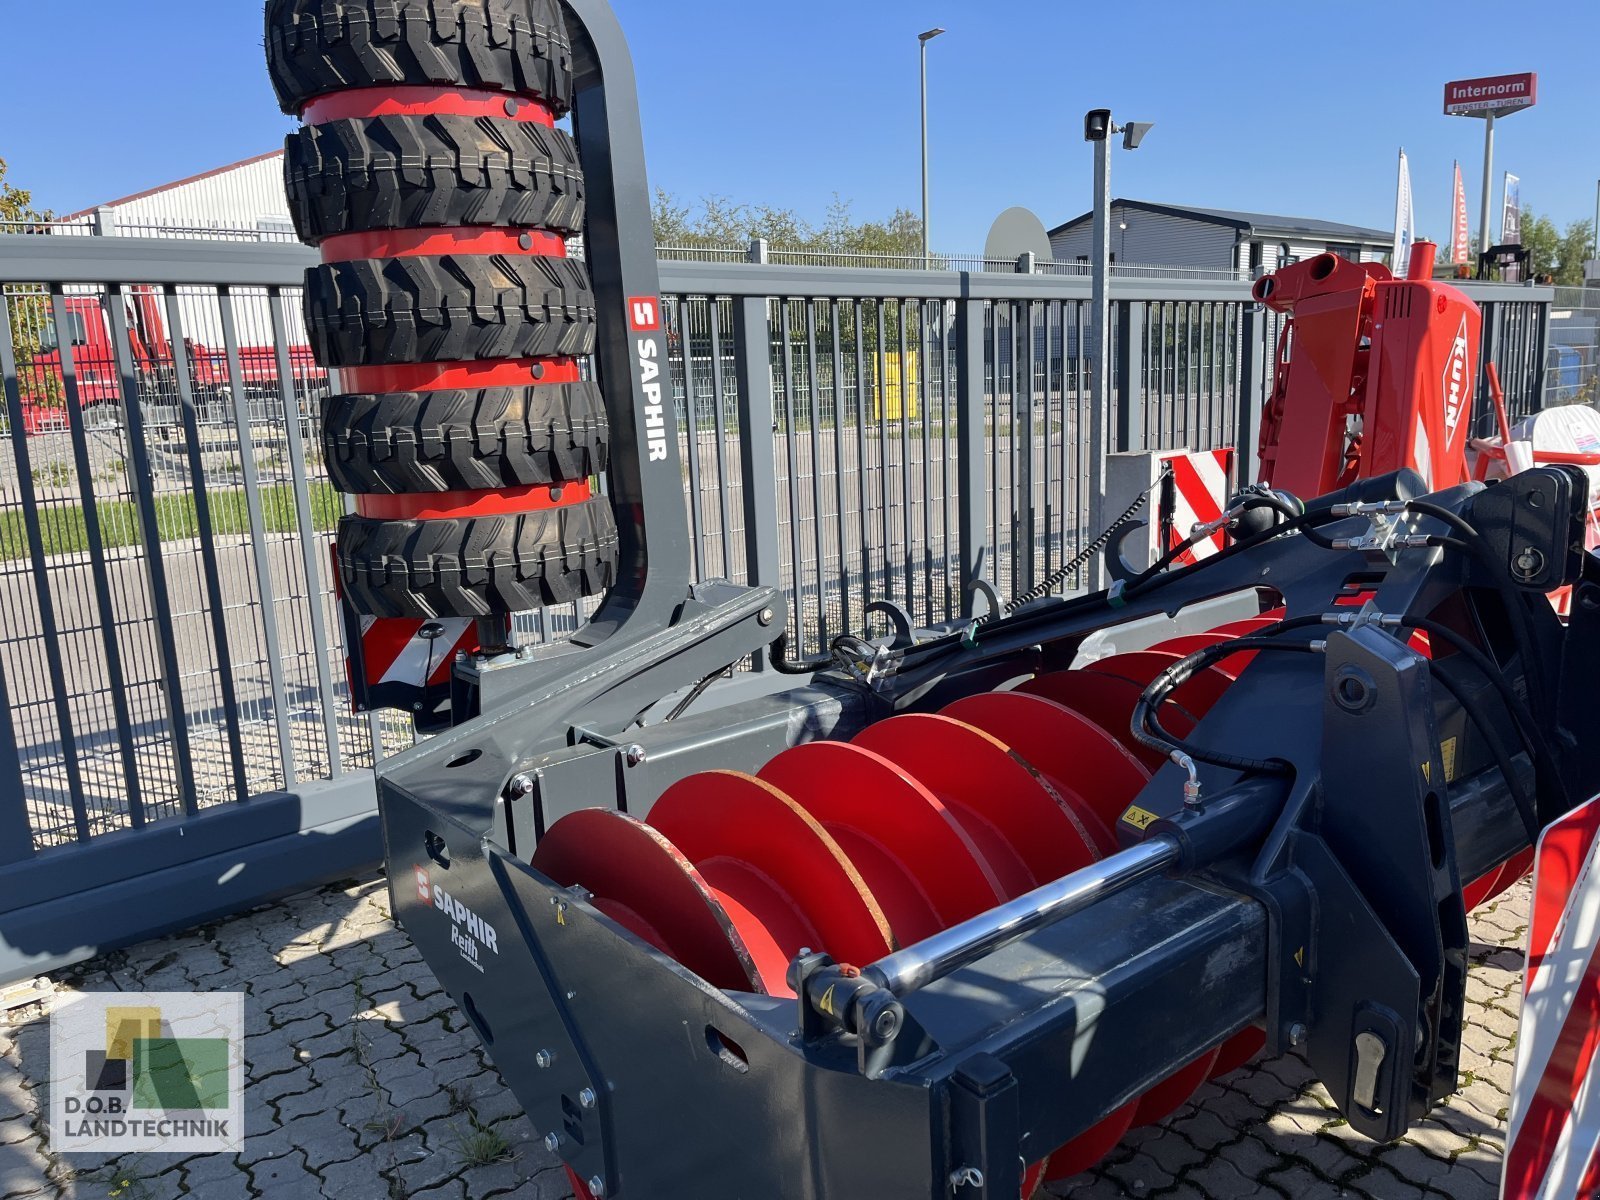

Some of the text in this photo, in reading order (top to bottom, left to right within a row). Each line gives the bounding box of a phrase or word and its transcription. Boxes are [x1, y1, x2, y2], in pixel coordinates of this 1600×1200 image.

[1453, 82, 1525, 99] Internorm
[1453, 102, 1489, 112] FENSTER
[638, 338, 668, 462] SAPHIR
[1446, 336, 1466, 428] KUHN
[433, 884, 499, 955] SAPHIR
[451, 923, 479, 961] Reith
